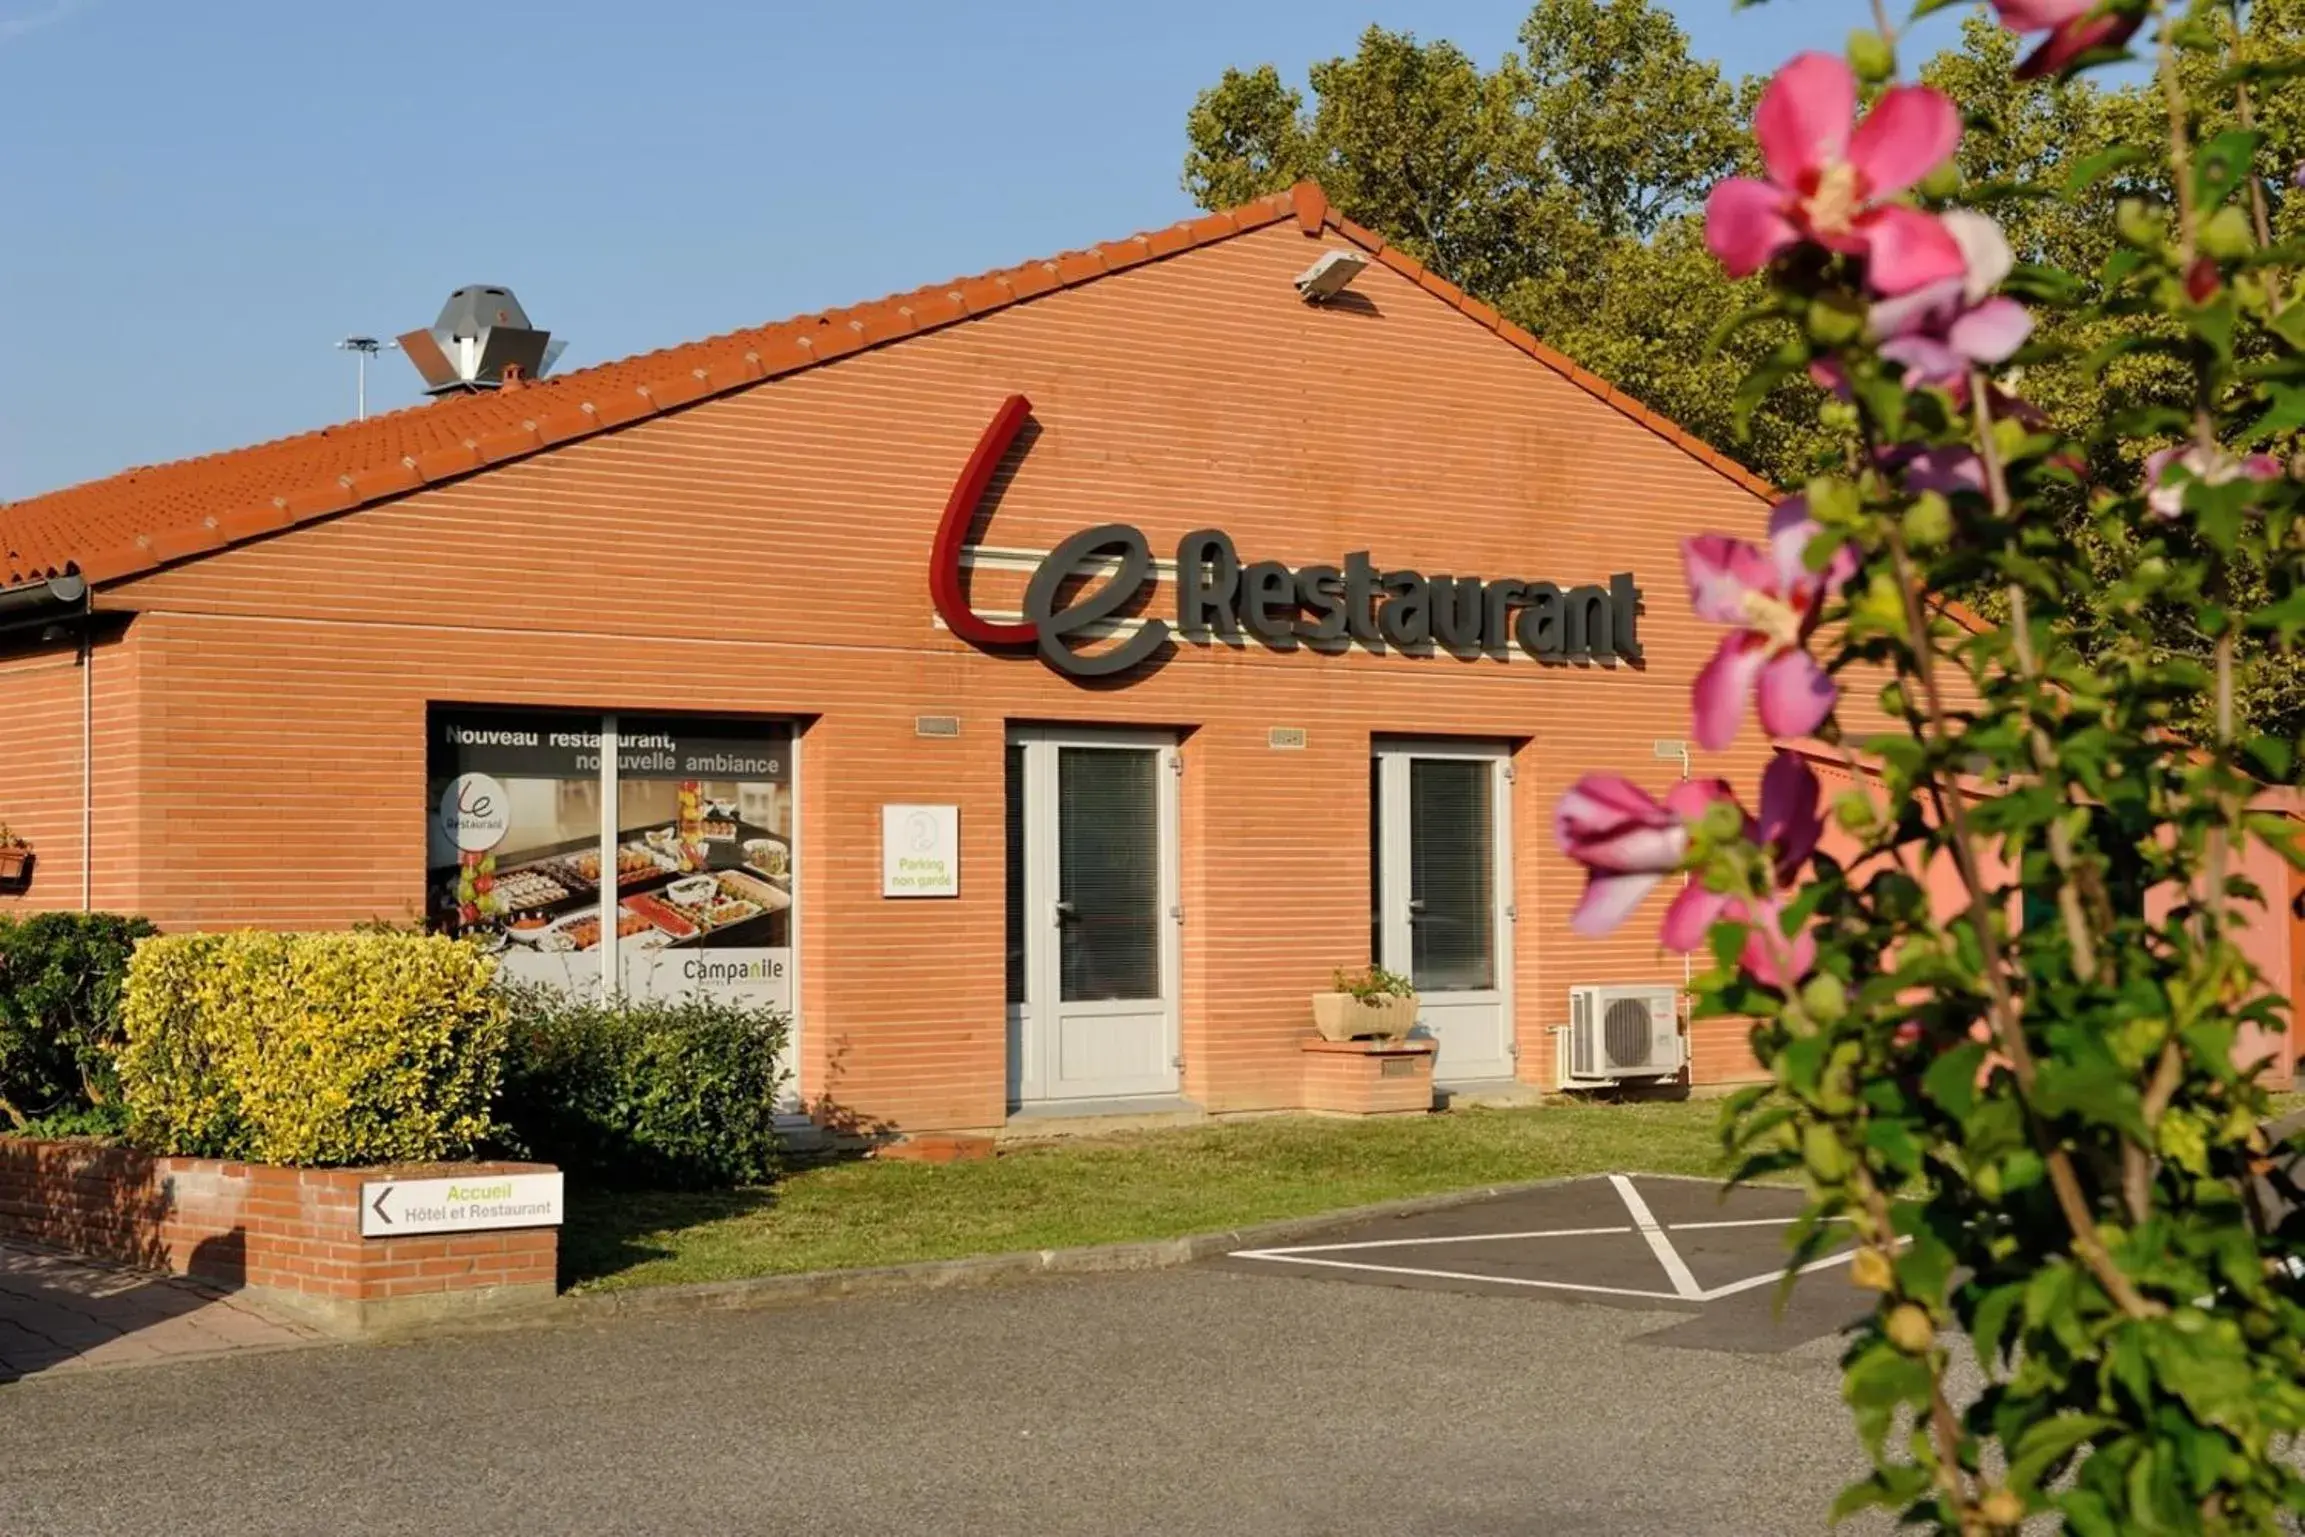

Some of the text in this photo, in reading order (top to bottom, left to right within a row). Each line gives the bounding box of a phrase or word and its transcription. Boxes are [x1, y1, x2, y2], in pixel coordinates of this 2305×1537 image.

[929, 394, 1642, 677] Le Restaurant
[446, 725, 538, 746] Nouveau
[575, 752, 779, 773] nouvelle ambiance
[899, 857, 944, 873] Parking
[892, 877, 916, 886] non
[684, 958, 783, 985] Campanile
[447, 1184, 512, 1202] Accueil
[405, 1201, 551, 1223] Hôtel et Restaurant
